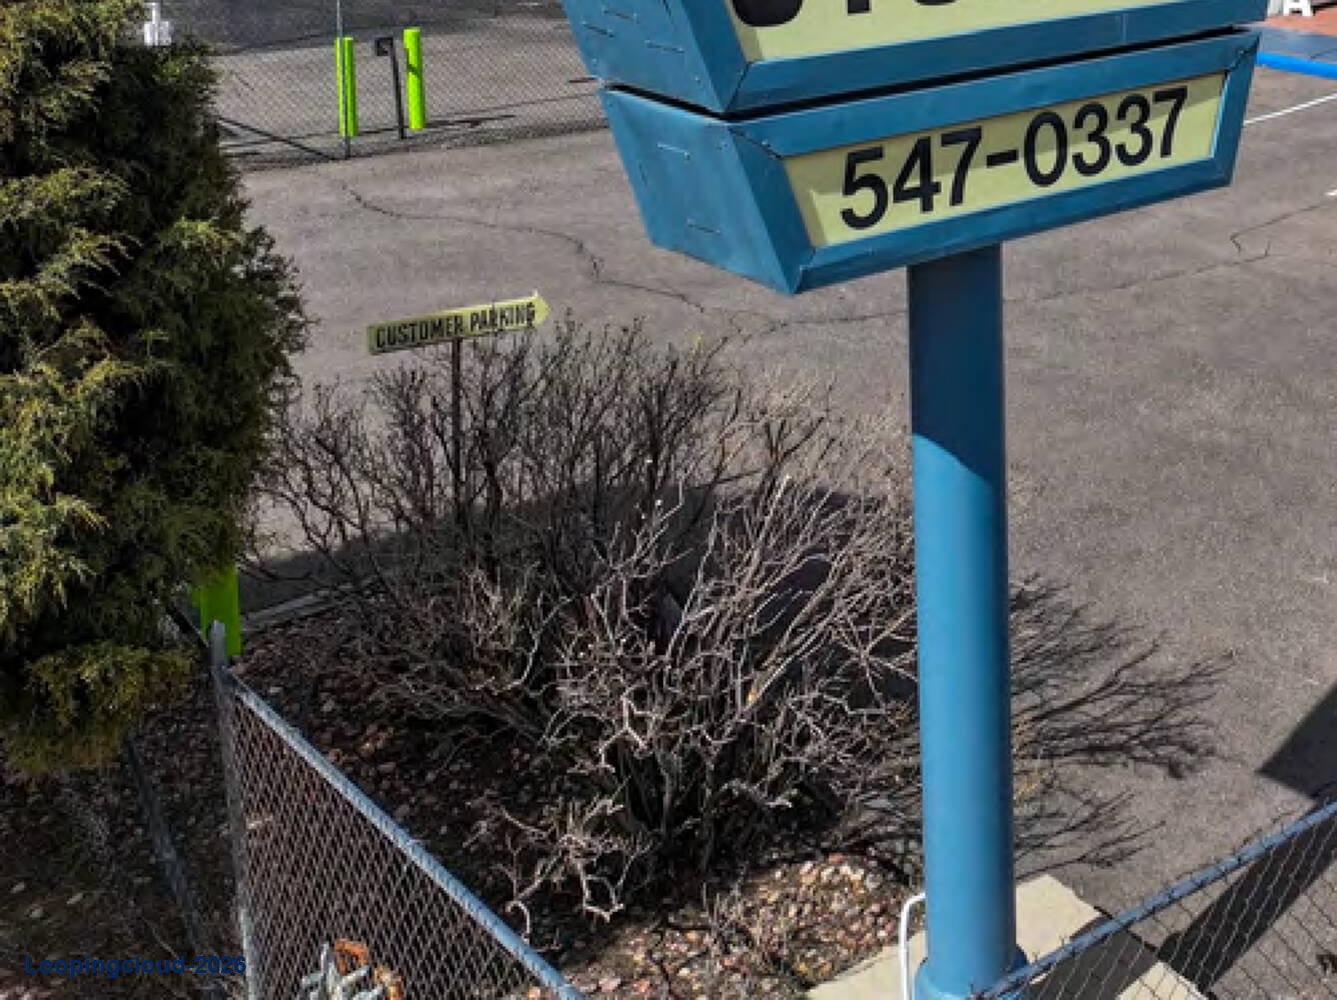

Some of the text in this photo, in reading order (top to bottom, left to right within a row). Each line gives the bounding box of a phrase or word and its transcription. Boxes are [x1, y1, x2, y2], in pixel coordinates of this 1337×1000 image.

[840, 86, 1188, 230] 547-0337
[376, 302, 535, 348] CUSTOMER PARKING
